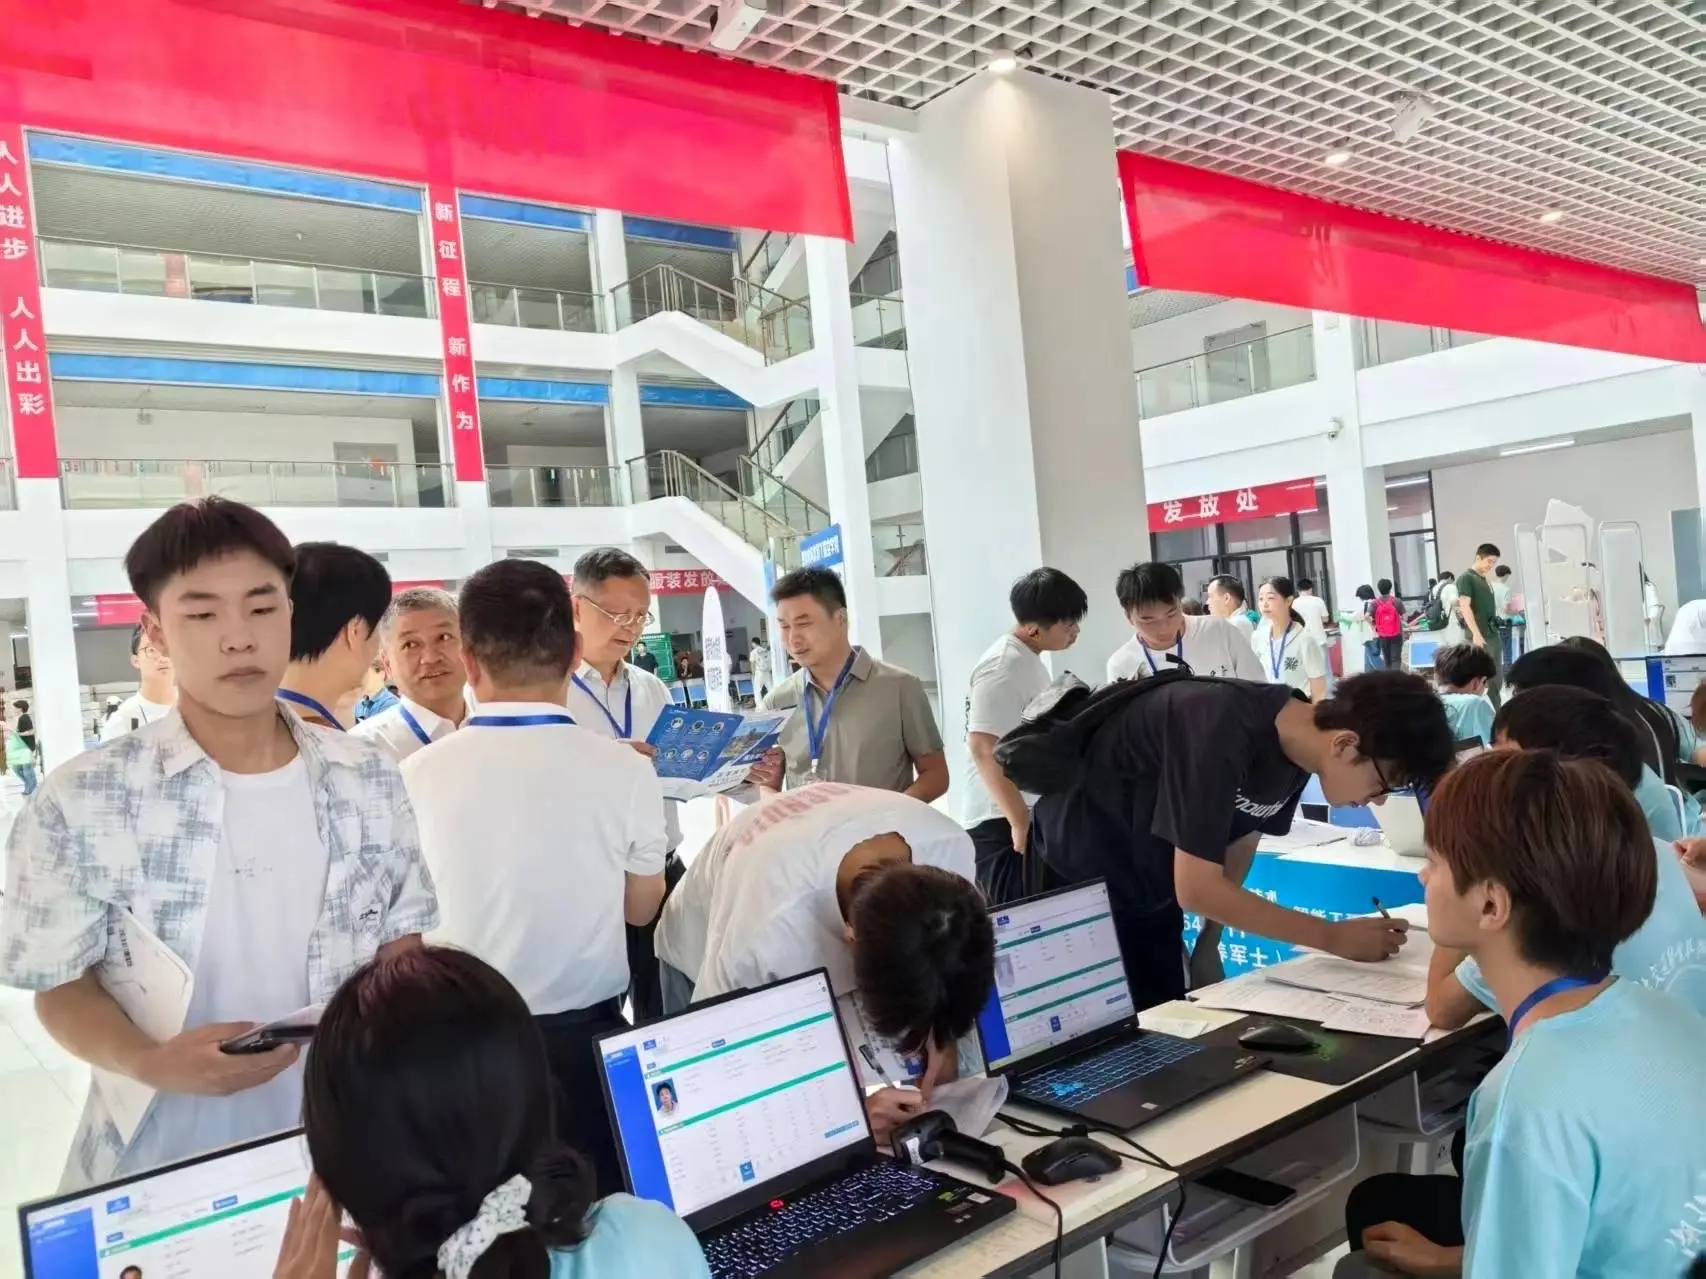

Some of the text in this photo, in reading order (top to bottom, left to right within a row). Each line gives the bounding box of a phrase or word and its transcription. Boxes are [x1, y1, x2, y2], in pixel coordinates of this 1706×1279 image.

[0, 141, 47, 416] 人人进步 人人出彩
[434, 202, 474, 431] 新征程 新作为
[1163, 487, 1259, 524] 发放处
